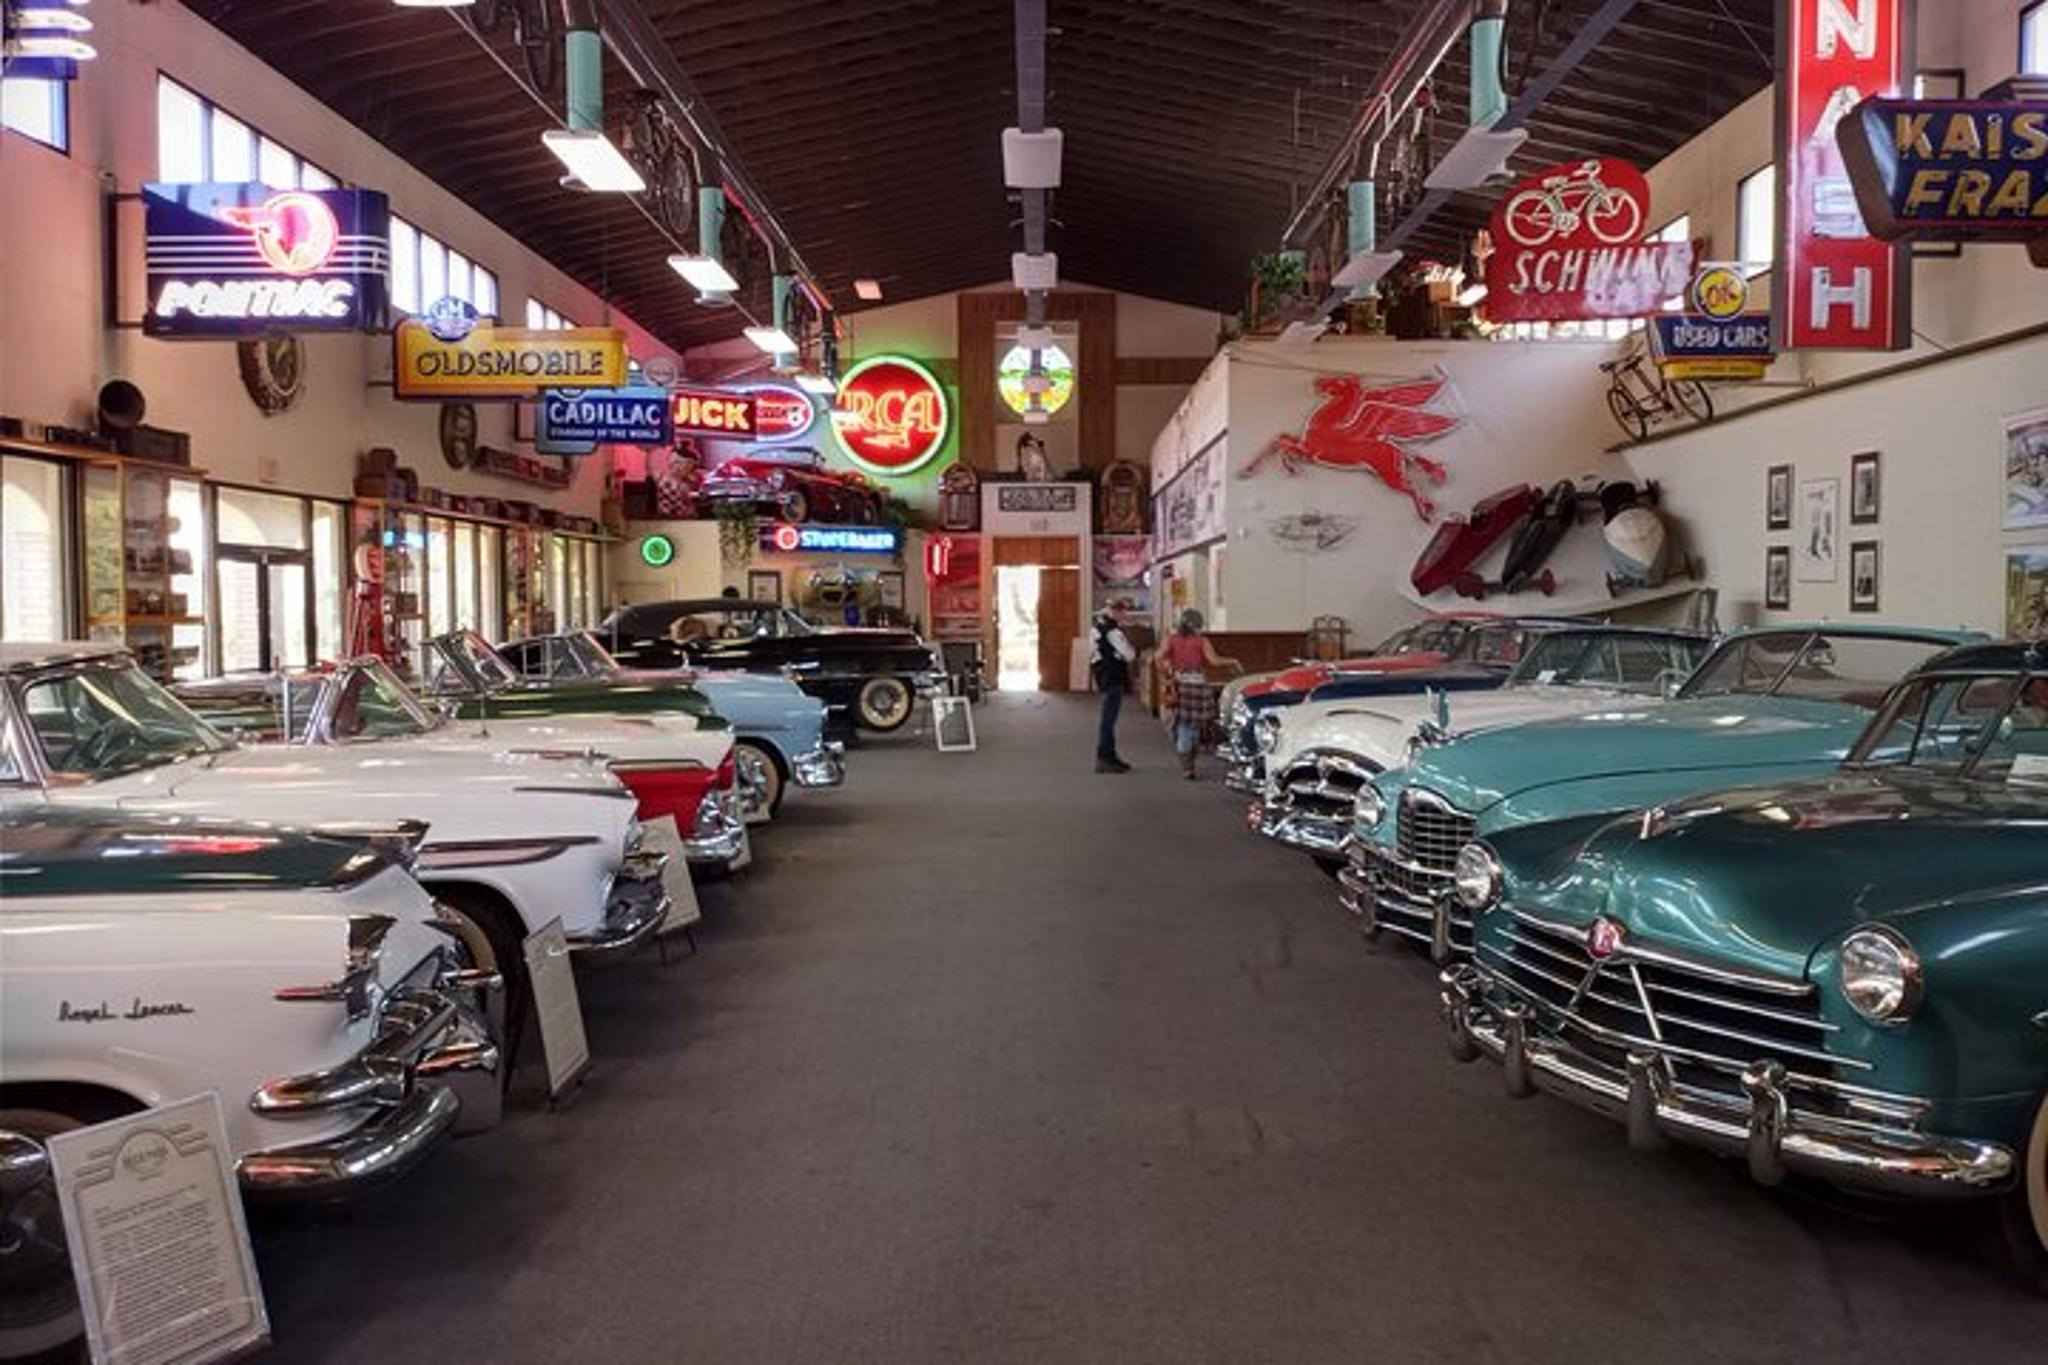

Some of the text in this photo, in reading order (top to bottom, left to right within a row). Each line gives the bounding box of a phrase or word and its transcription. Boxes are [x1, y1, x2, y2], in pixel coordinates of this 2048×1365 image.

[1508, 245, 1691, 294] SCHWINN
[155, 278, 354, 317] PONTIAC
[1673, 325, 1768, 349] USED CARS
[416, 350, 604, 377] OLDSMOBILE
[550, 402, 661, 425] CADILLAC
[840, 388, 942, 440] RCA
